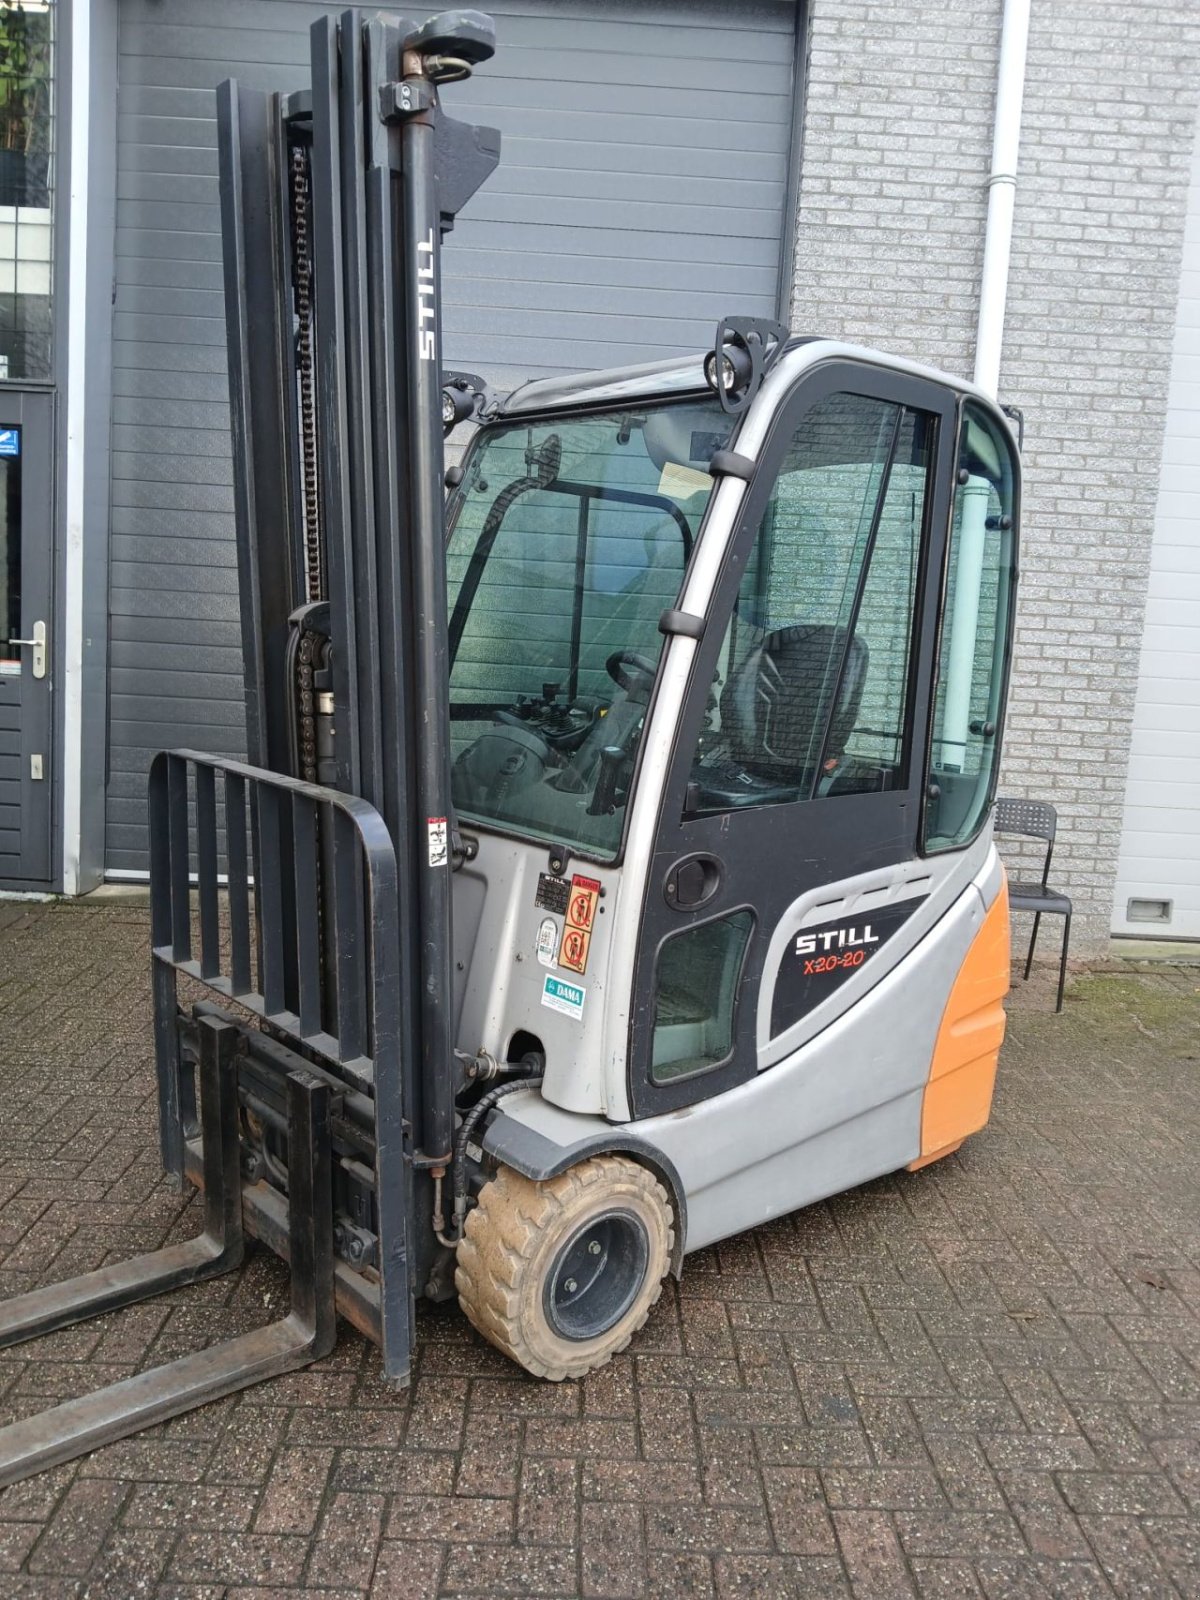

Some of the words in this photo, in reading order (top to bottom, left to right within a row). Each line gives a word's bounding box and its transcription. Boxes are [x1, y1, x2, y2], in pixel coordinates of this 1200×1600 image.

[418, 228, 435, 360] STILL
[545, 875, 565, 885] STILL
[796, 925, 879, 955] STILL
[804, 950, 864, 975] X20-20
[557, 984, 580, 1003] DAMA
